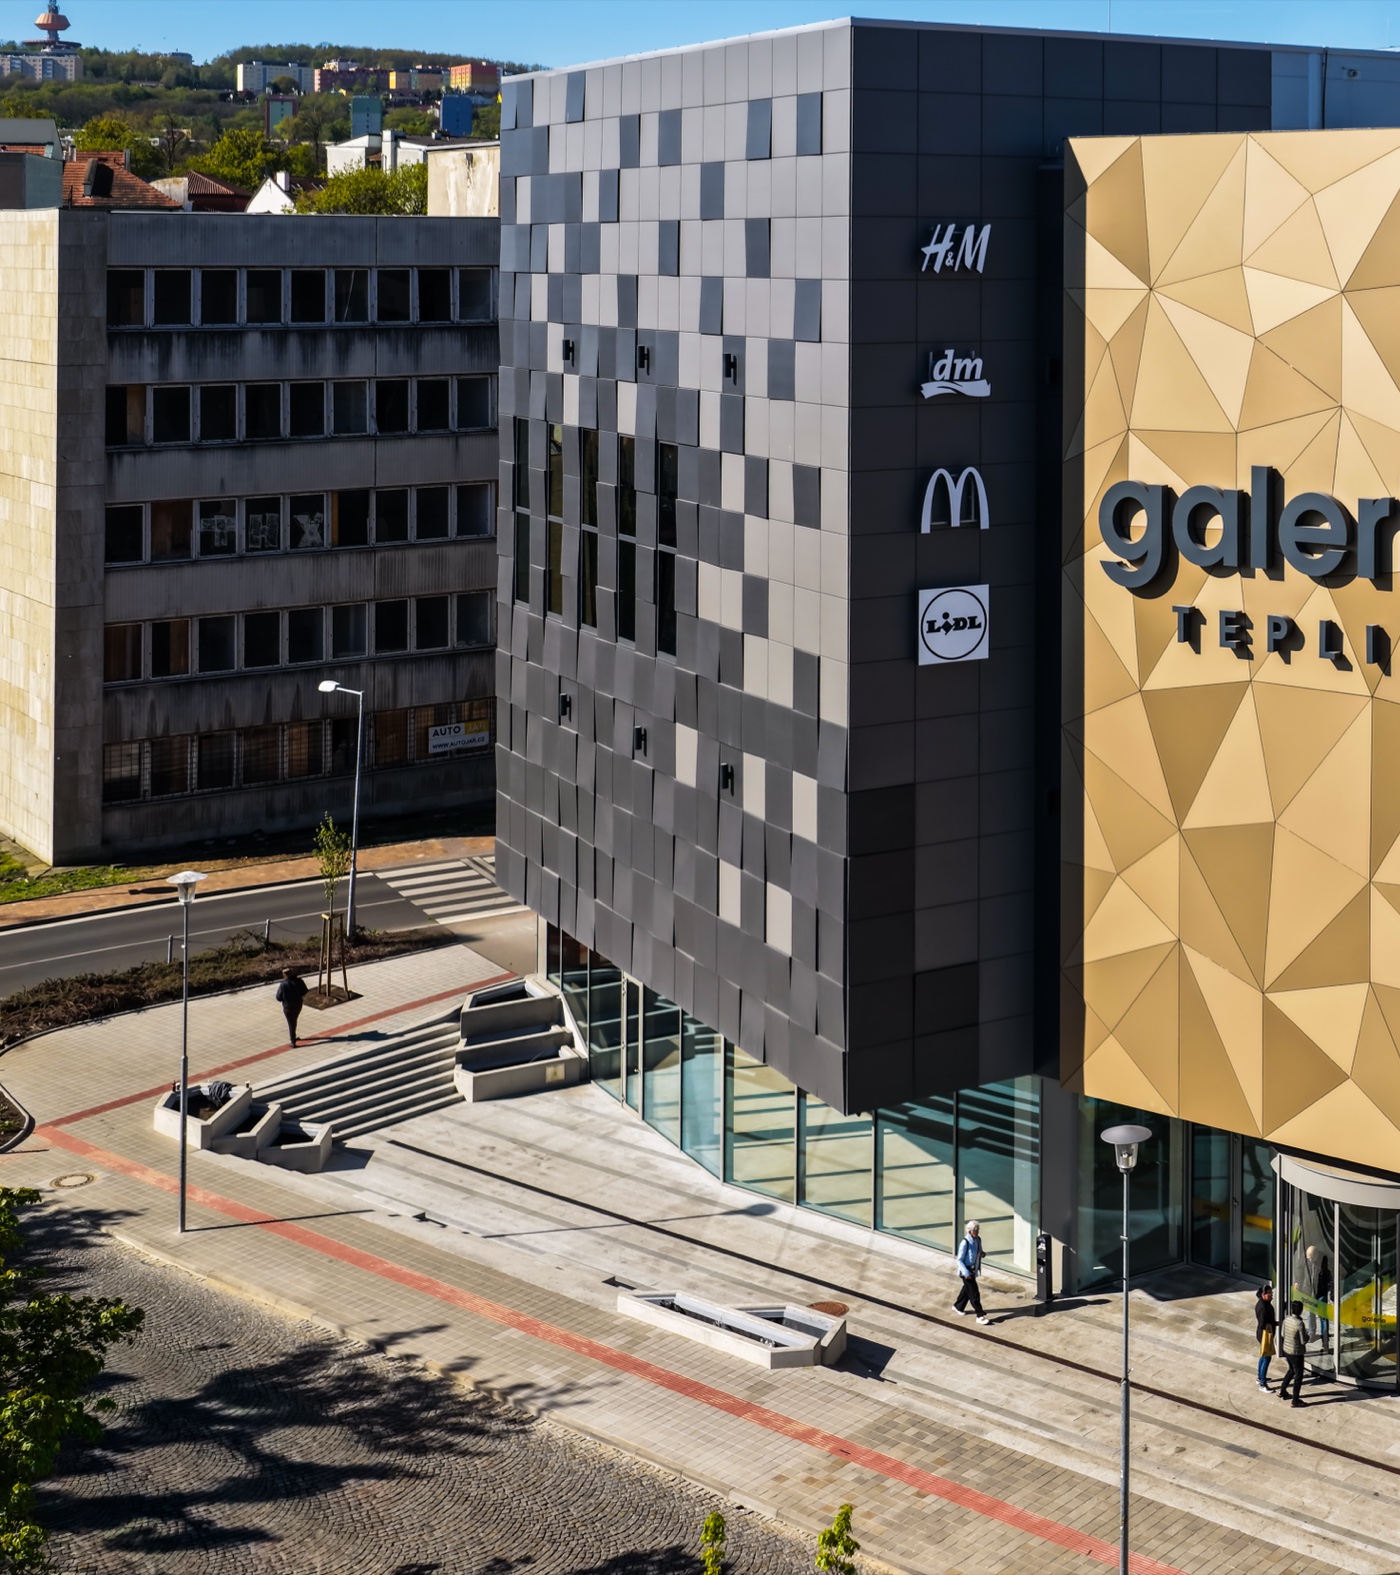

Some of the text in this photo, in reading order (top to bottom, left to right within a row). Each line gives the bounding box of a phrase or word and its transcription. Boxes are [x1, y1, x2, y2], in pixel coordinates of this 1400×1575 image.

[921, 223, 991, 274] H&M
[933, 349, 983, 381] dm
[432, 722, 486, 738] AUTO JAR
